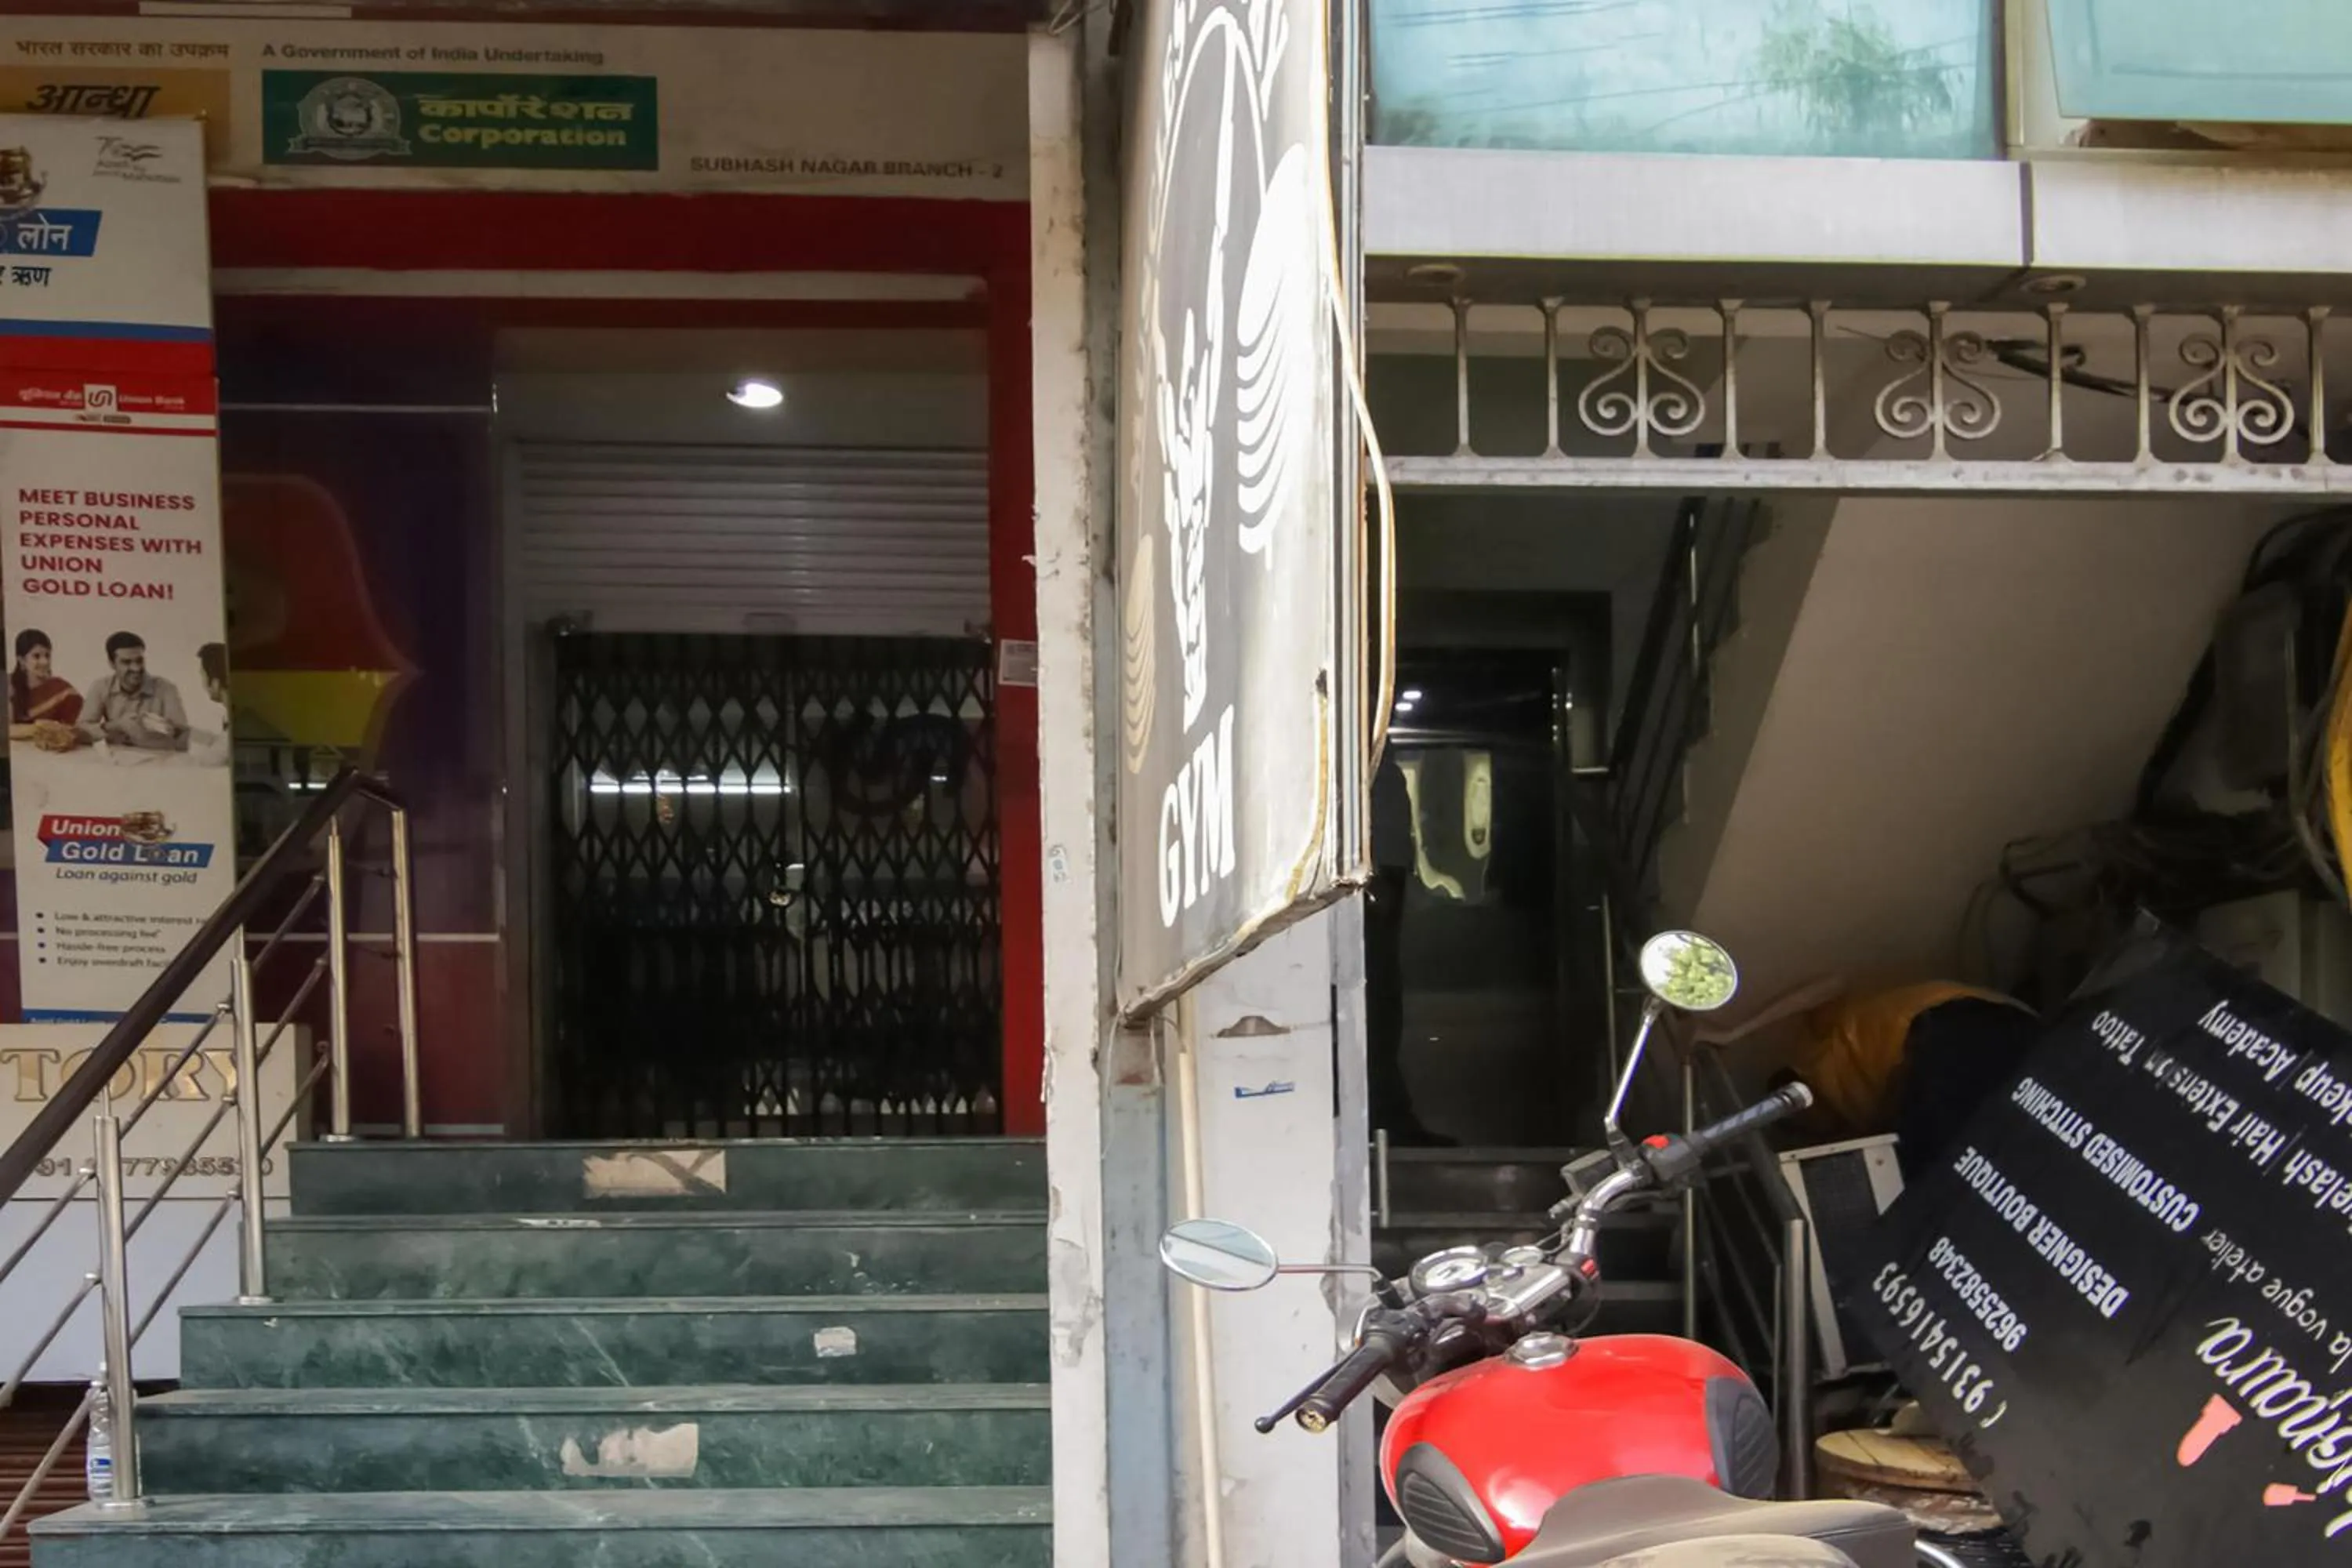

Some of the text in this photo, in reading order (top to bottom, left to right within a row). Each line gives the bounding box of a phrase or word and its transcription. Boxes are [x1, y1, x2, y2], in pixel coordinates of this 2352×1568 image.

[16, 41, 230, 60] भारत सरकार का उपक्रम
[263, 44, 604, 66] A Government of India Undertaking
[417, 123, 628, 150] Corporation
[690, 157, 794, 174] SUBHASH
[883, 161, 973, 178] BRANCH
[17, 212, 74, 251] लोन
[12, 266, 53, 288] ऋण
[19, 488, 195, 510] MEET BUSINESS
[20, 510, 140, 530] PERSONAL
[20, 533, 202, 554] EXPENSES WITH
[21, 555, 103, 573] UNION
[23, 579, 174, 600] GOLD LOAN!
[50, 818, 122, 837] Union
[1159, 704, 1236, 928] GYM
[61, 840, 125, 861] Gold
[56, 867, 198, 884] Loan against gold
[2091, 1011, 2145, 1066] Tattoo
[2197, 1000, 2352, 1126] keup Academy
[2228, 1112, 2286, 1167] Hair
[2011, 1077, 2201, 1232] CUSTOMISED STITCHING
[2282, 1149, 2352, 1234] elash
[1954, 1146, 2130, 1318] DESIGNER BOUTIQUE
[2202, 1230, 2266, 1283] atelier
[1929, 1237, 2027, 1352] 9625582348
[2261, 1278, 2328, 1341] vogue
[1873, 1262, 1994, 1414] 9315416593
